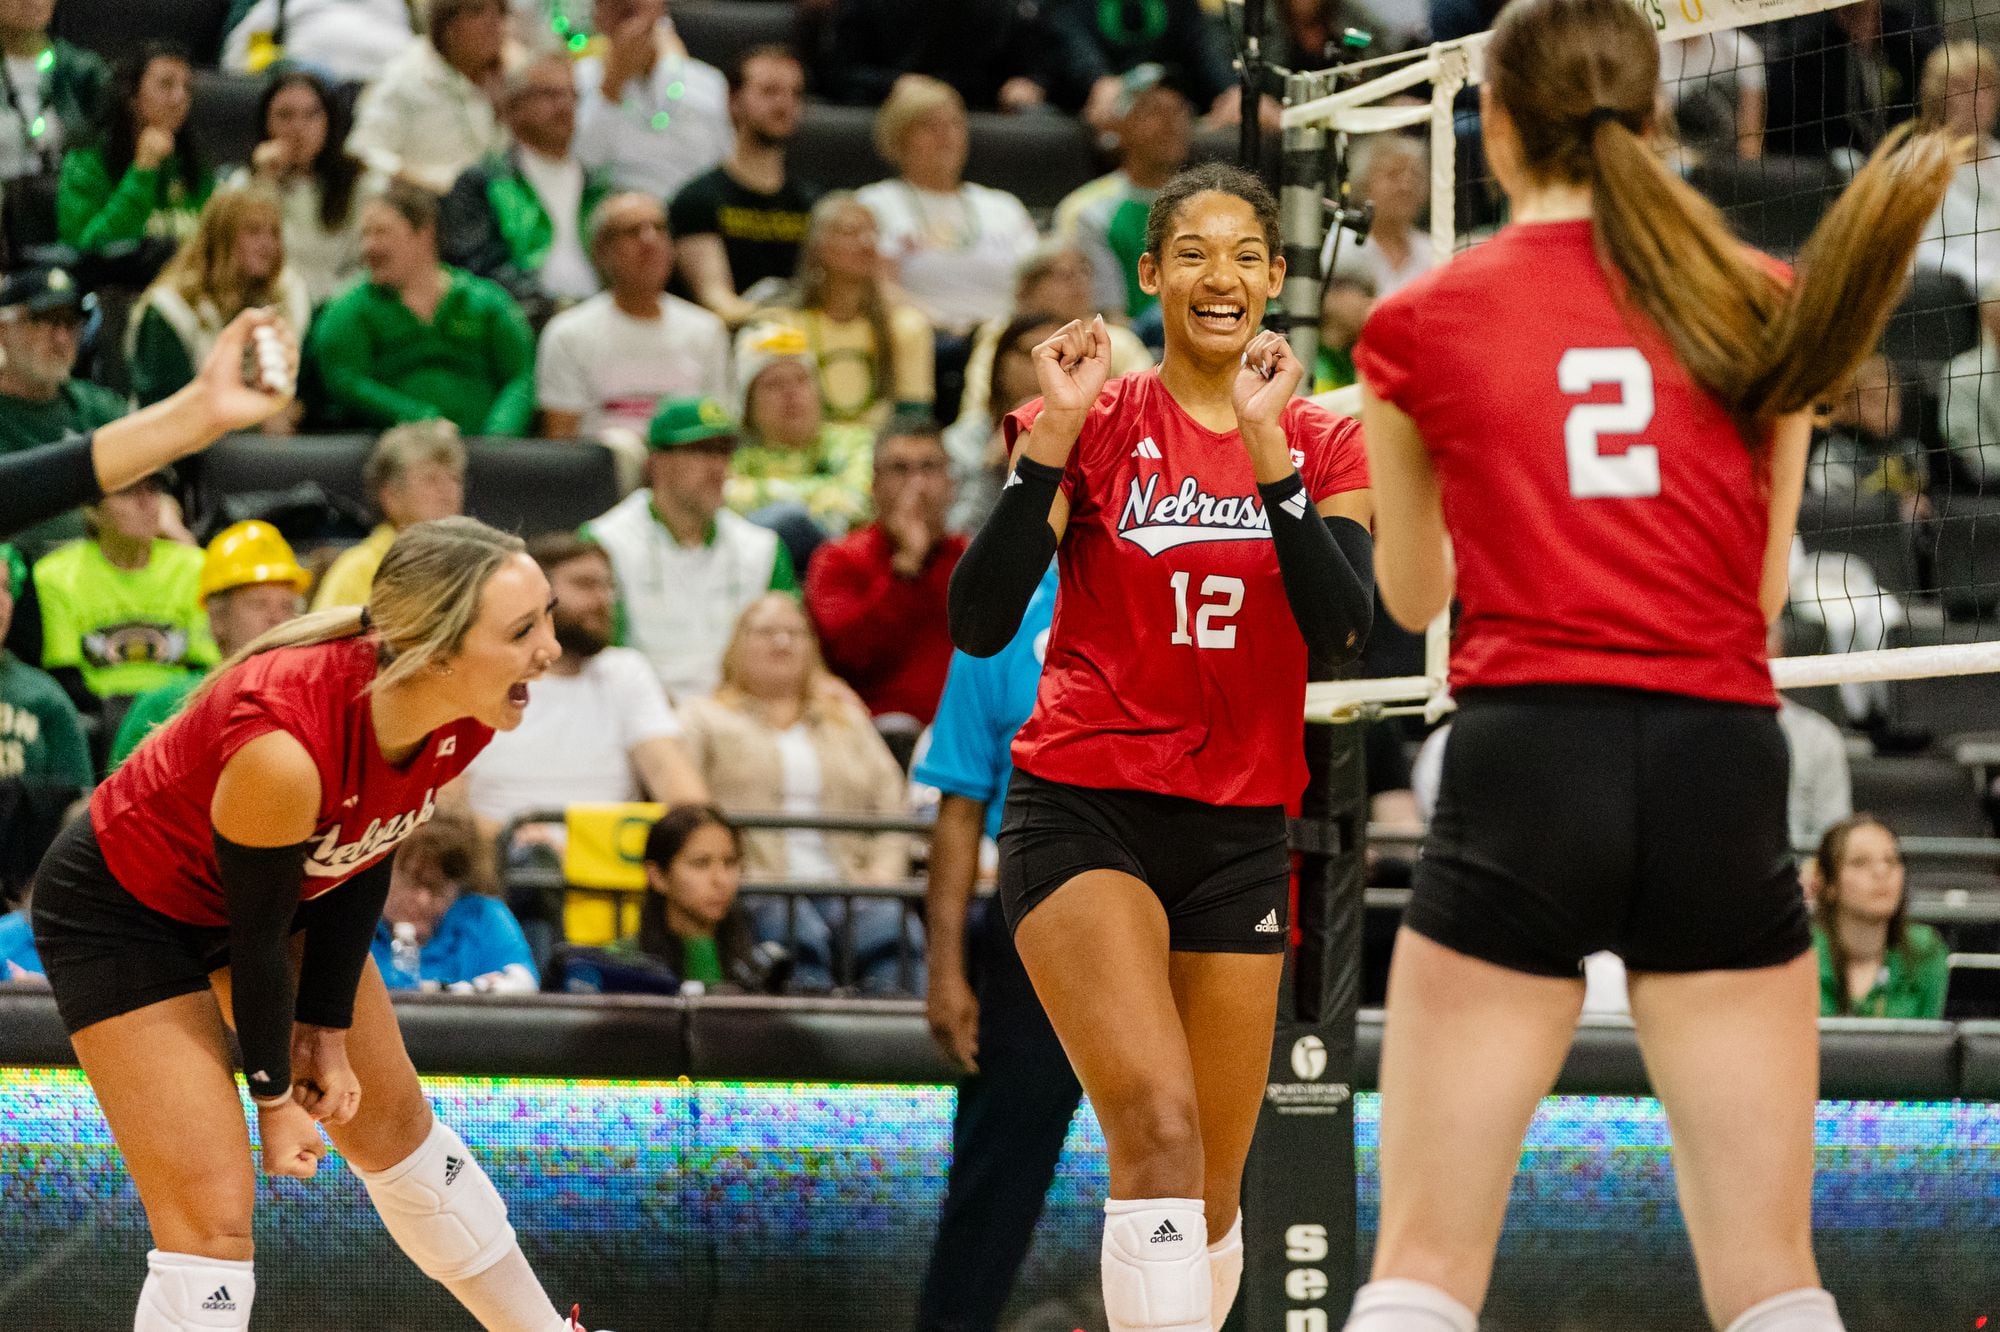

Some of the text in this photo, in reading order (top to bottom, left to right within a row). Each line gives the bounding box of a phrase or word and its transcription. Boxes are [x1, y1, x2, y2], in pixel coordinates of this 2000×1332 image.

[1557, 347, 1661, 498] 2
[1170, 571, 1245, 649] 12
[1150, 1233, 1184, 1243] adidas
